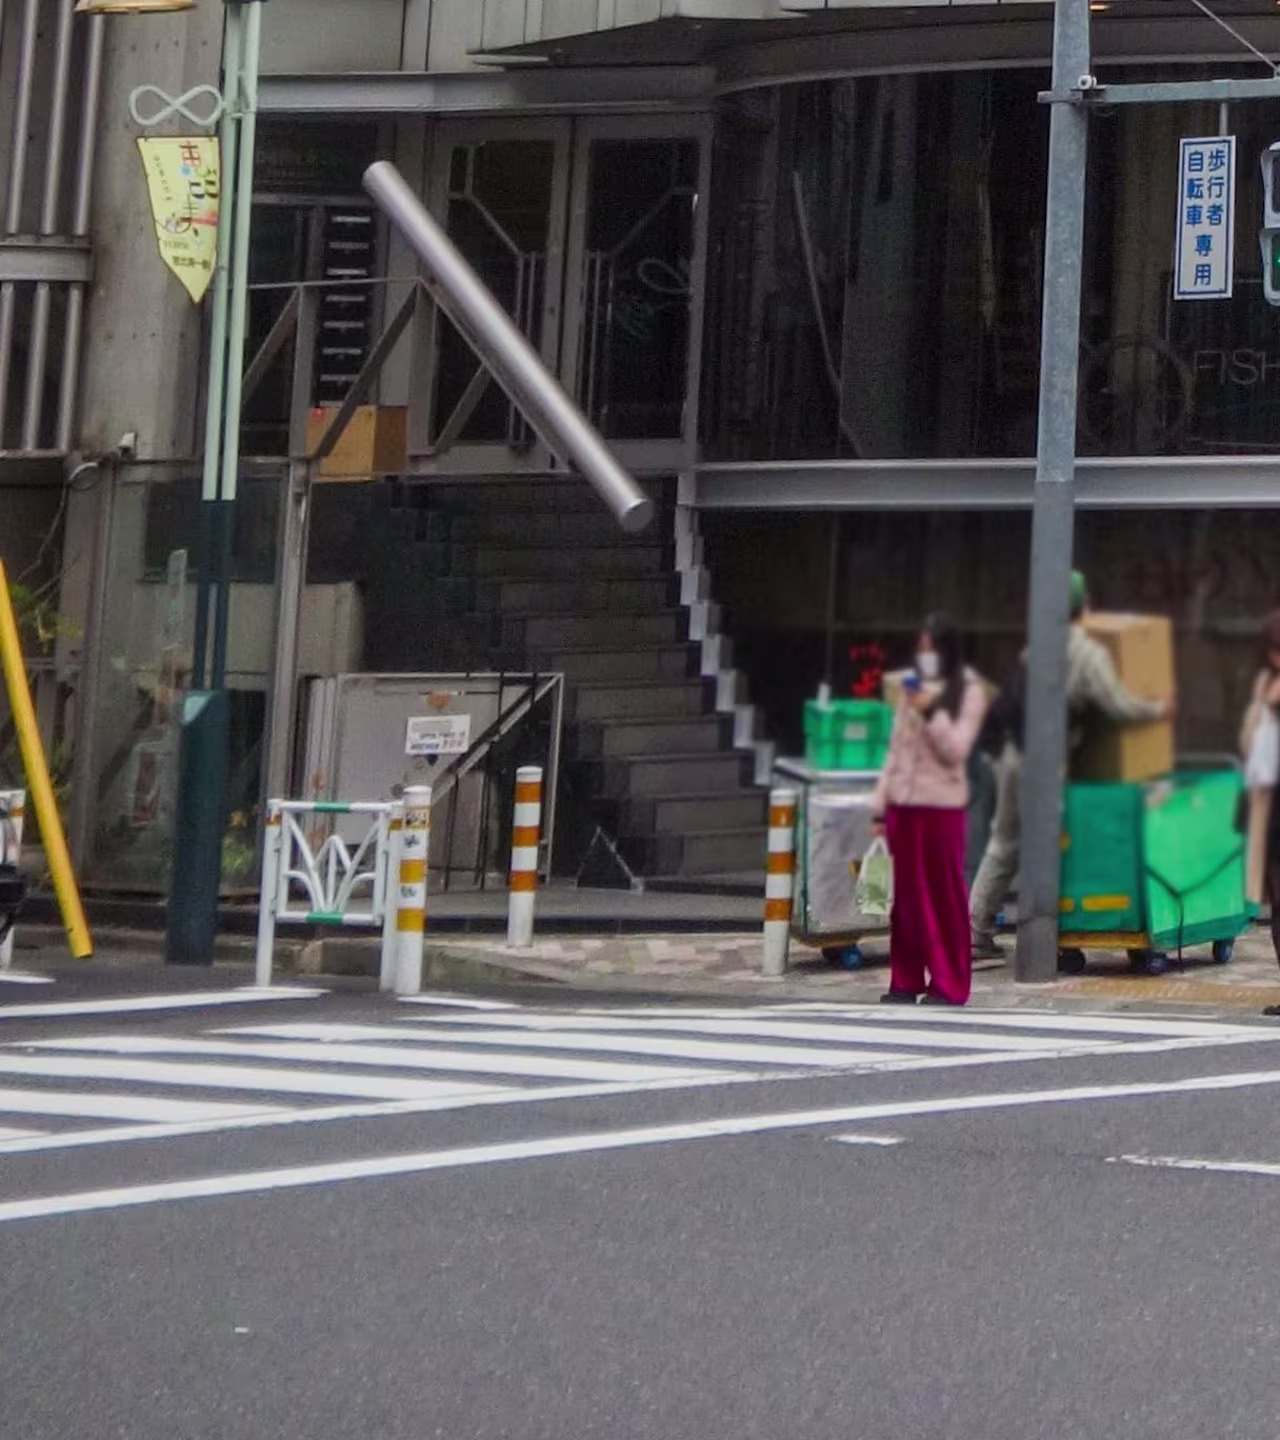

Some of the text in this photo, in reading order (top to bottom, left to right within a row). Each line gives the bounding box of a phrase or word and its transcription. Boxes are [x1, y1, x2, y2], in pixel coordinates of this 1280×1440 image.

[1185, 150, 1204, 227] 自転車
[1205, 148, 1226, 227] 歩行者
[1193, 234, 1213, 287] 専用
